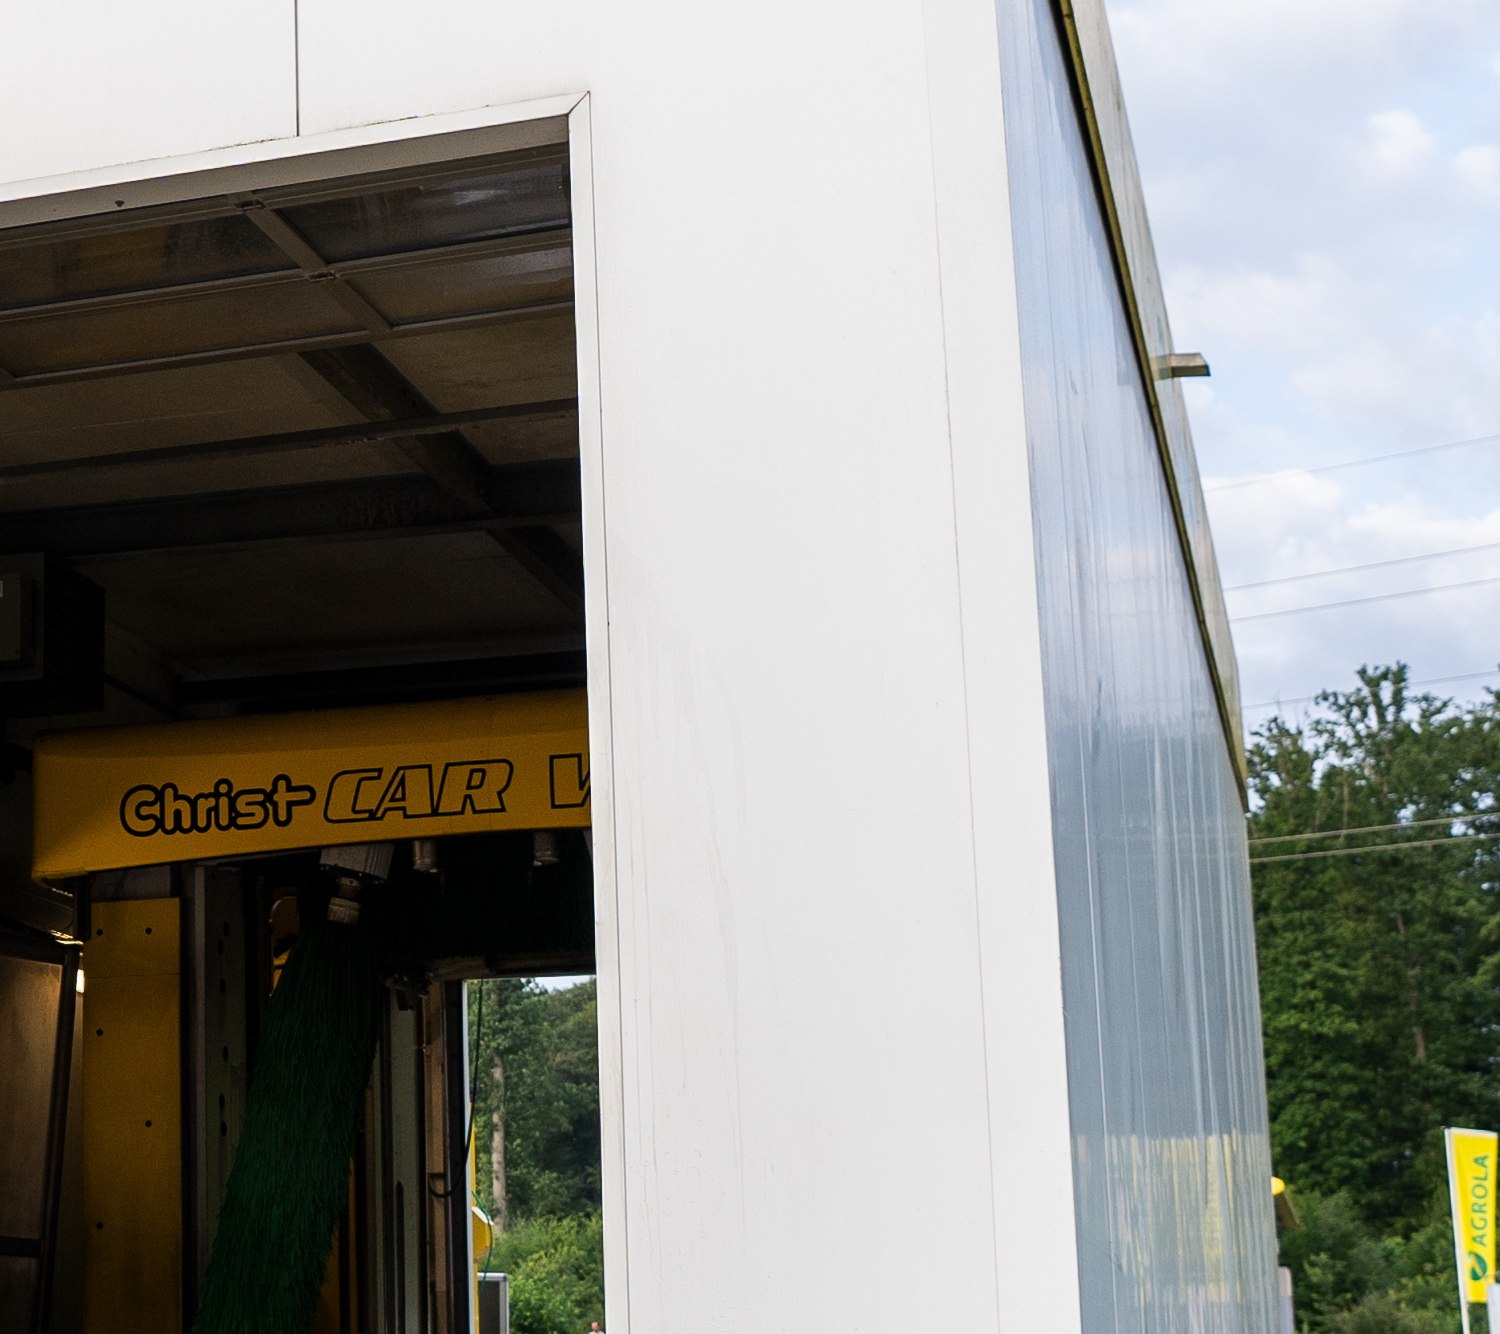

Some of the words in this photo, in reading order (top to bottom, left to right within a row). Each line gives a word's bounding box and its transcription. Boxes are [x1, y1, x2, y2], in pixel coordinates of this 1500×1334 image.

[120, 774, 316, 837] Christ
[323, 758, 514, 824] CAR
[1470, 1155, 1490, 1247] AGROLA
